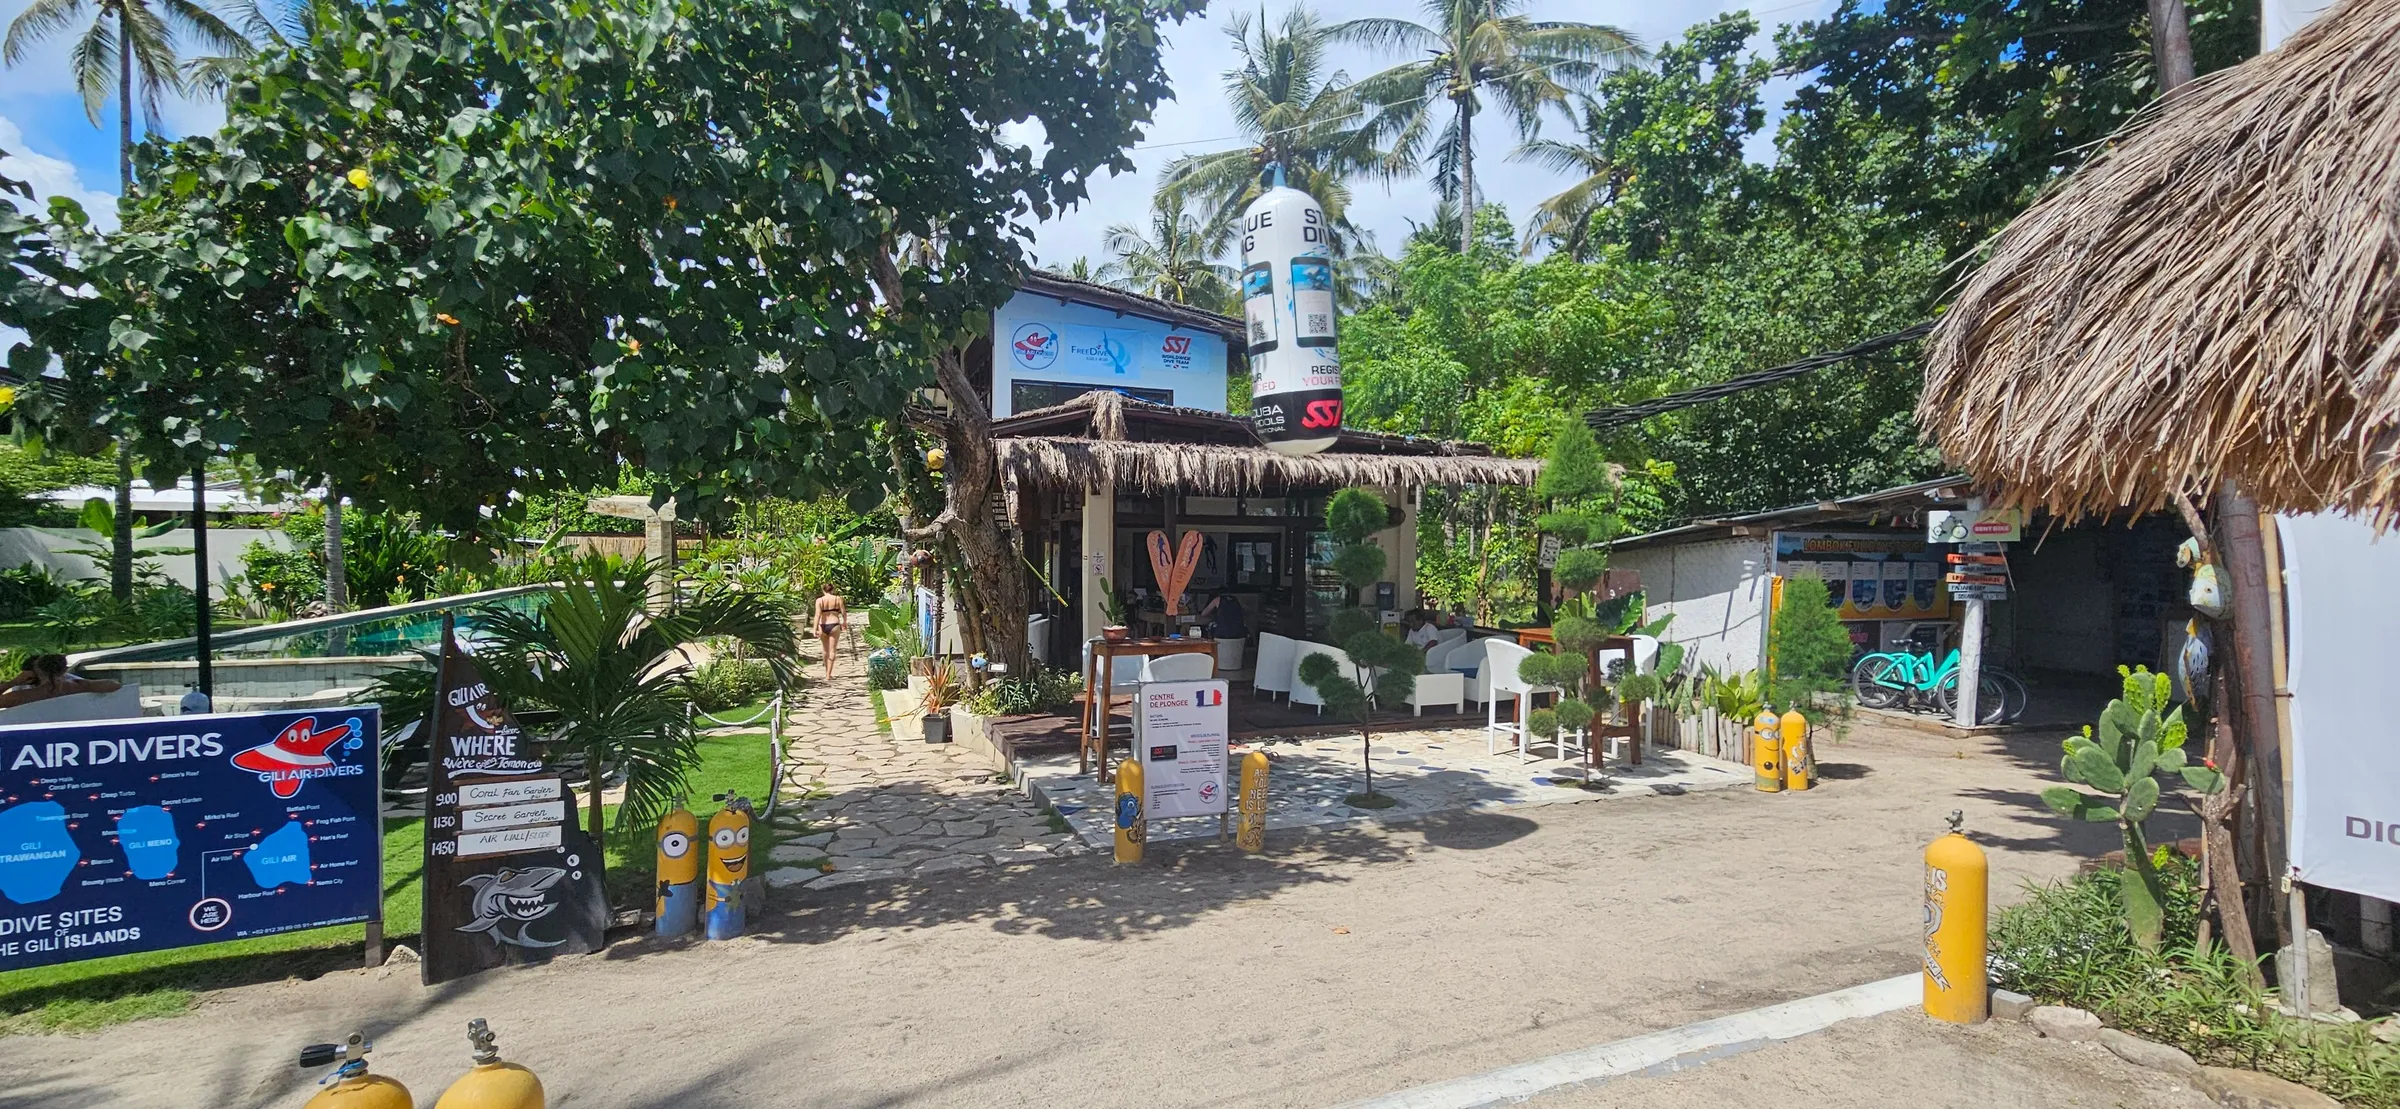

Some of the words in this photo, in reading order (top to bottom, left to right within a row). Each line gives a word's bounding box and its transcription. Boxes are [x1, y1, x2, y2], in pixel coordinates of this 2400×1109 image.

[1242, 210, 1273, 236] UE
[1162, 336, 1192, 355] SSI
[1310, 364, 1339, 375] REGIS
[1301, 399, 1342, 429] SSI
[469, 682, 490, 700] AIR
[1149, 693, 1175, 701] CENTRE
[1149, 700, 1159, 708] DE
[10, 742, 80, 771] AIR
[88, 732, 224, 765] DIVERS
[450, 735, 518, 757] WHERE
[258, 771, 285, 783] GILI
[313, 764, 364, 778] DIVERS
[470, 787, 499, 799] Coral
[473, 811, 507, 823] Secret
[129, 841, 146, 850] GILI
[146, 839, 172, 848] MENO
[479, 834, 498, 844] AIR
[20, 842, 42, 851] GILI
[0, 850, 66, 864] TRAWANGAN
[261, 857, 280, 865] GILI
[281, 854, 297, 863] AIR
[0, 914, 52, 937] DIVE
[58, 906, 123, 928] SITES
[200, 917, 220, 925] HERE
[54, 929, 70, 938] OF
[0, 942, 19, 957] HE
[24, 938, 59, 953] GILI
[64, 927, 141, 949] ISLANDS
